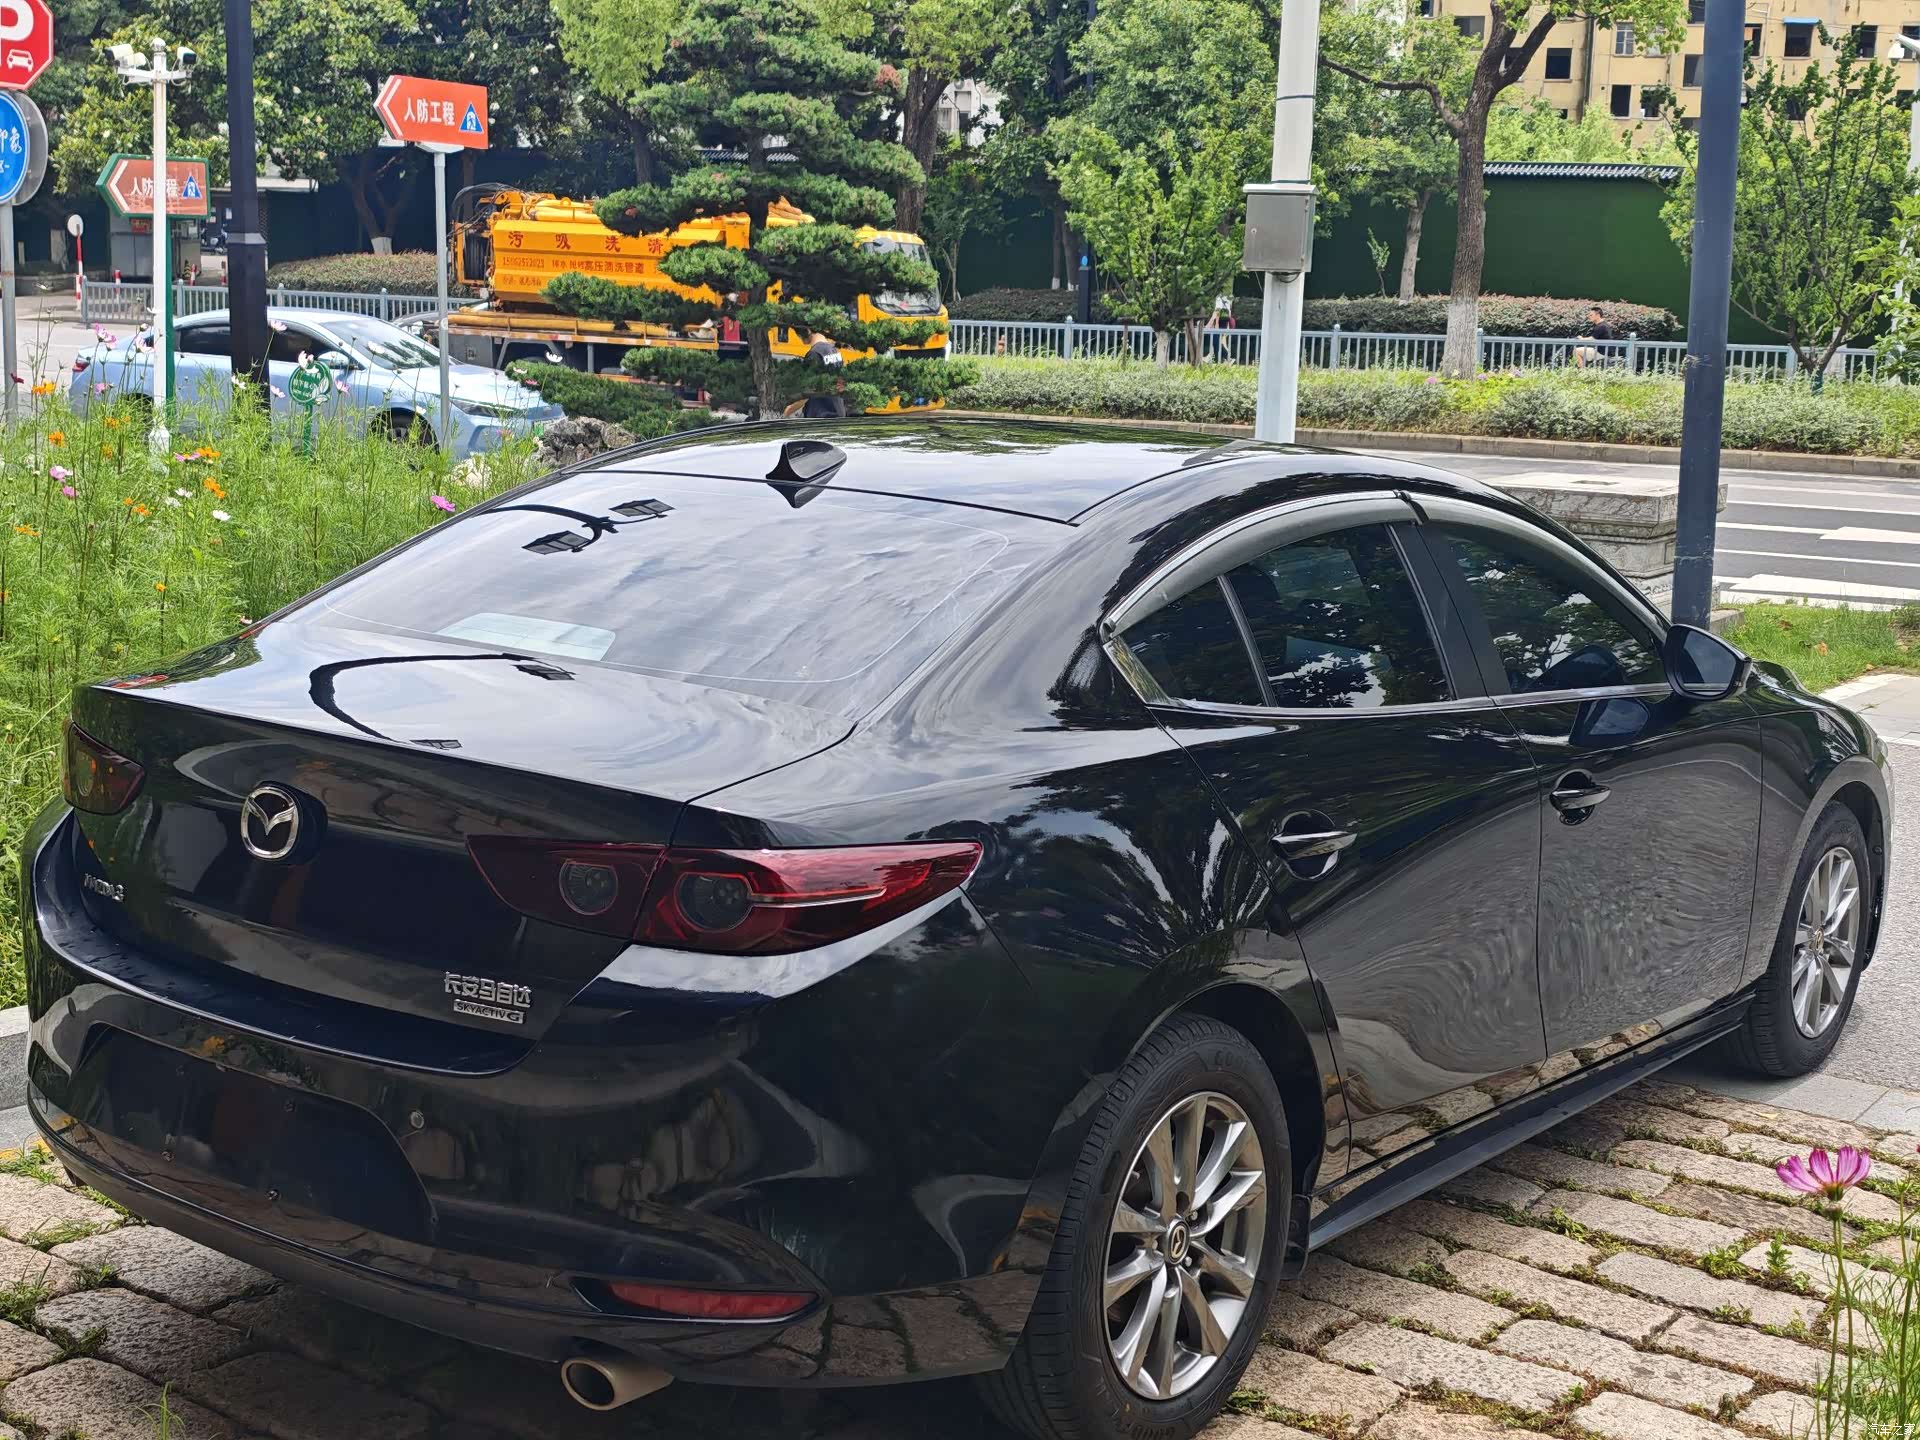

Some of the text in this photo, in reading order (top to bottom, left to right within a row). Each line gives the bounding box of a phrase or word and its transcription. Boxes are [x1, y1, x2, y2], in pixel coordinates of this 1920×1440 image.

[403, 97, 455, 126] 人防工程
[130, 176, 178, 198] 人防程
[444, 971, 532, 1008] 长安马自达
